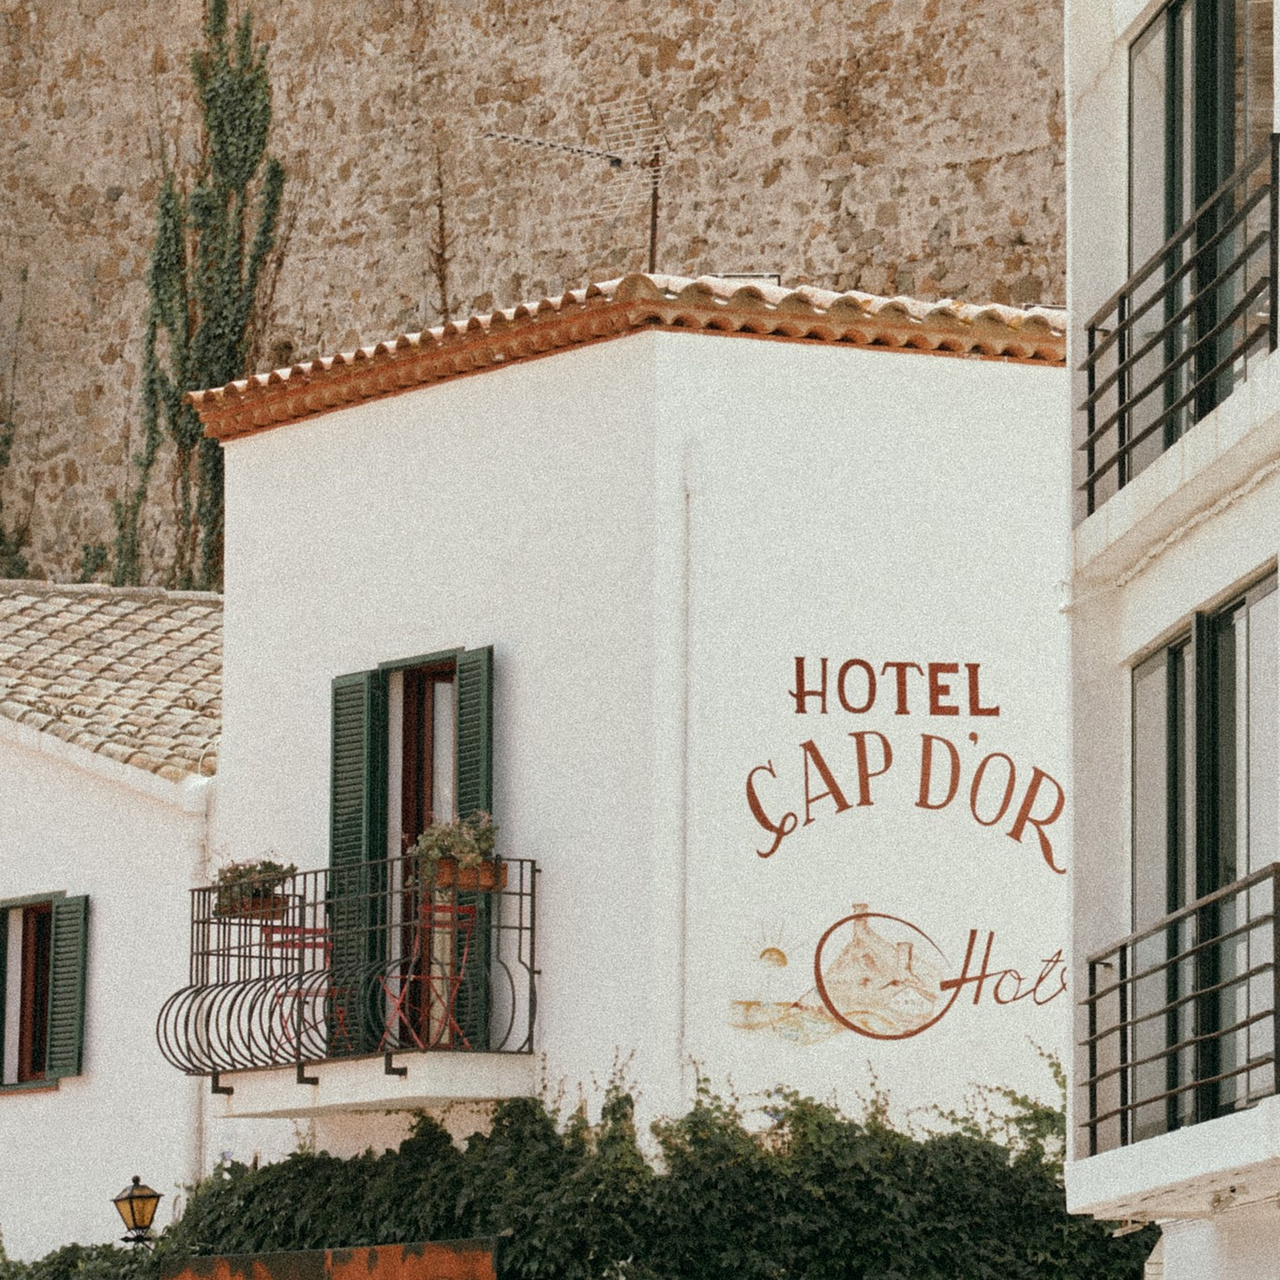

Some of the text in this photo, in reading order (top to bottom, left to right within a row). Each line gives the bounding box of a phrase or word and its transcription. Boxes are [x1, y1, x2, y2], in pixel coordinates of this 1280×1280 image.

[788, 656, 1000, 716] HOTEL
[746, 730, 1066, 875] CAP D'OR
